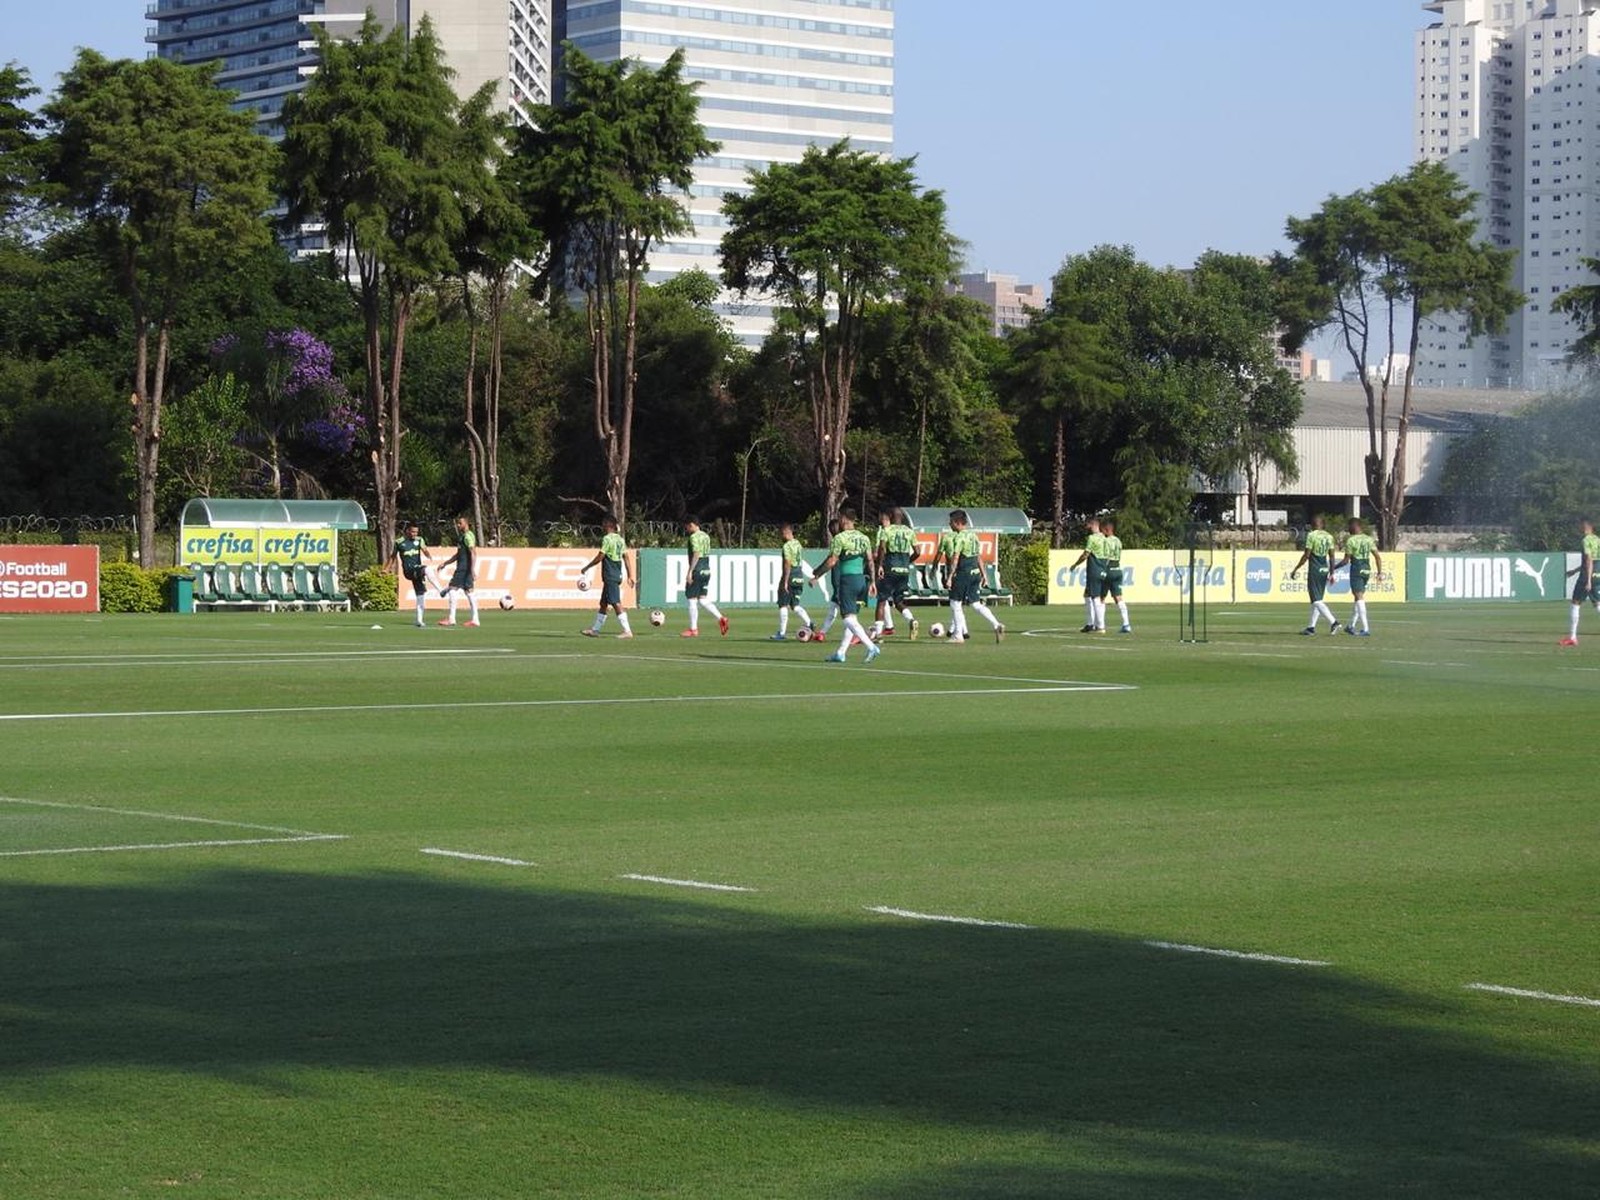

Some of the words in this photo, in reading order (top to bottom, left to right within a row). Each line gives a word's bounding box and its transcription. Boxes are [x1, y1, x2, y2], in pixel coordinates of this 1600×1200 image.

[186, 532, 254, 559] crefisa
[264, 532, 330, 559] crefisa
[0, 580, 88, 599] S2020
[1151, 558, 1226, 594] crefisa
[1279, 582, 1308, 593] CREFI
[1365, 583, 1396, 593] REFISA
[1425, 557, 1511, 598] PUMA
